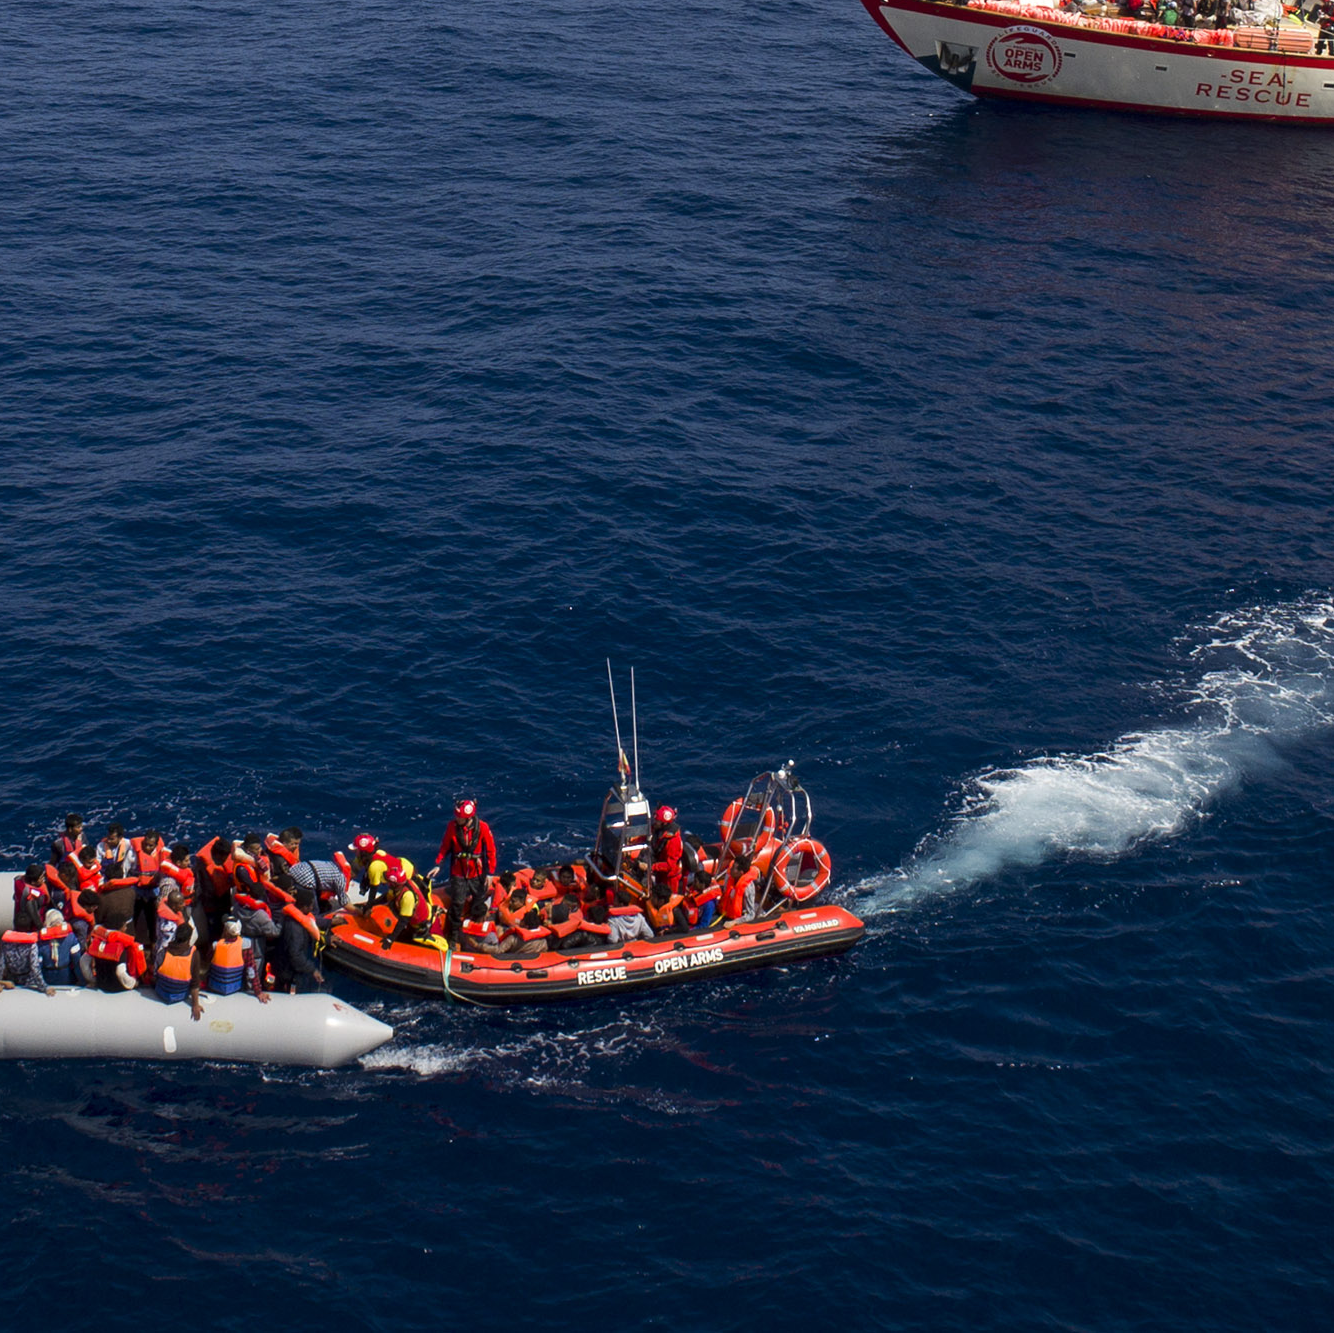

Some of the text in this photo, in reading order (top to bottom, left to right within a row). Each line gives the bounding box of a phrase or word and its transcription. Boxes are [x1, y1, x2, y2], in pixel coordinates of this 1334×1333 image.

[997, 26, 1057, 46] LIFEGUARD
[1004, 58, 1042, 72] ARMS
[1005, 48, 1044, 63] OPEN
[1195, 83, 1312, 108] RESCUE
[793, 918, 839, 934] VANGUARD
[654, 948, 724, 974] OPEN ARMS
[577, 966, 627, 985] RESCUE
